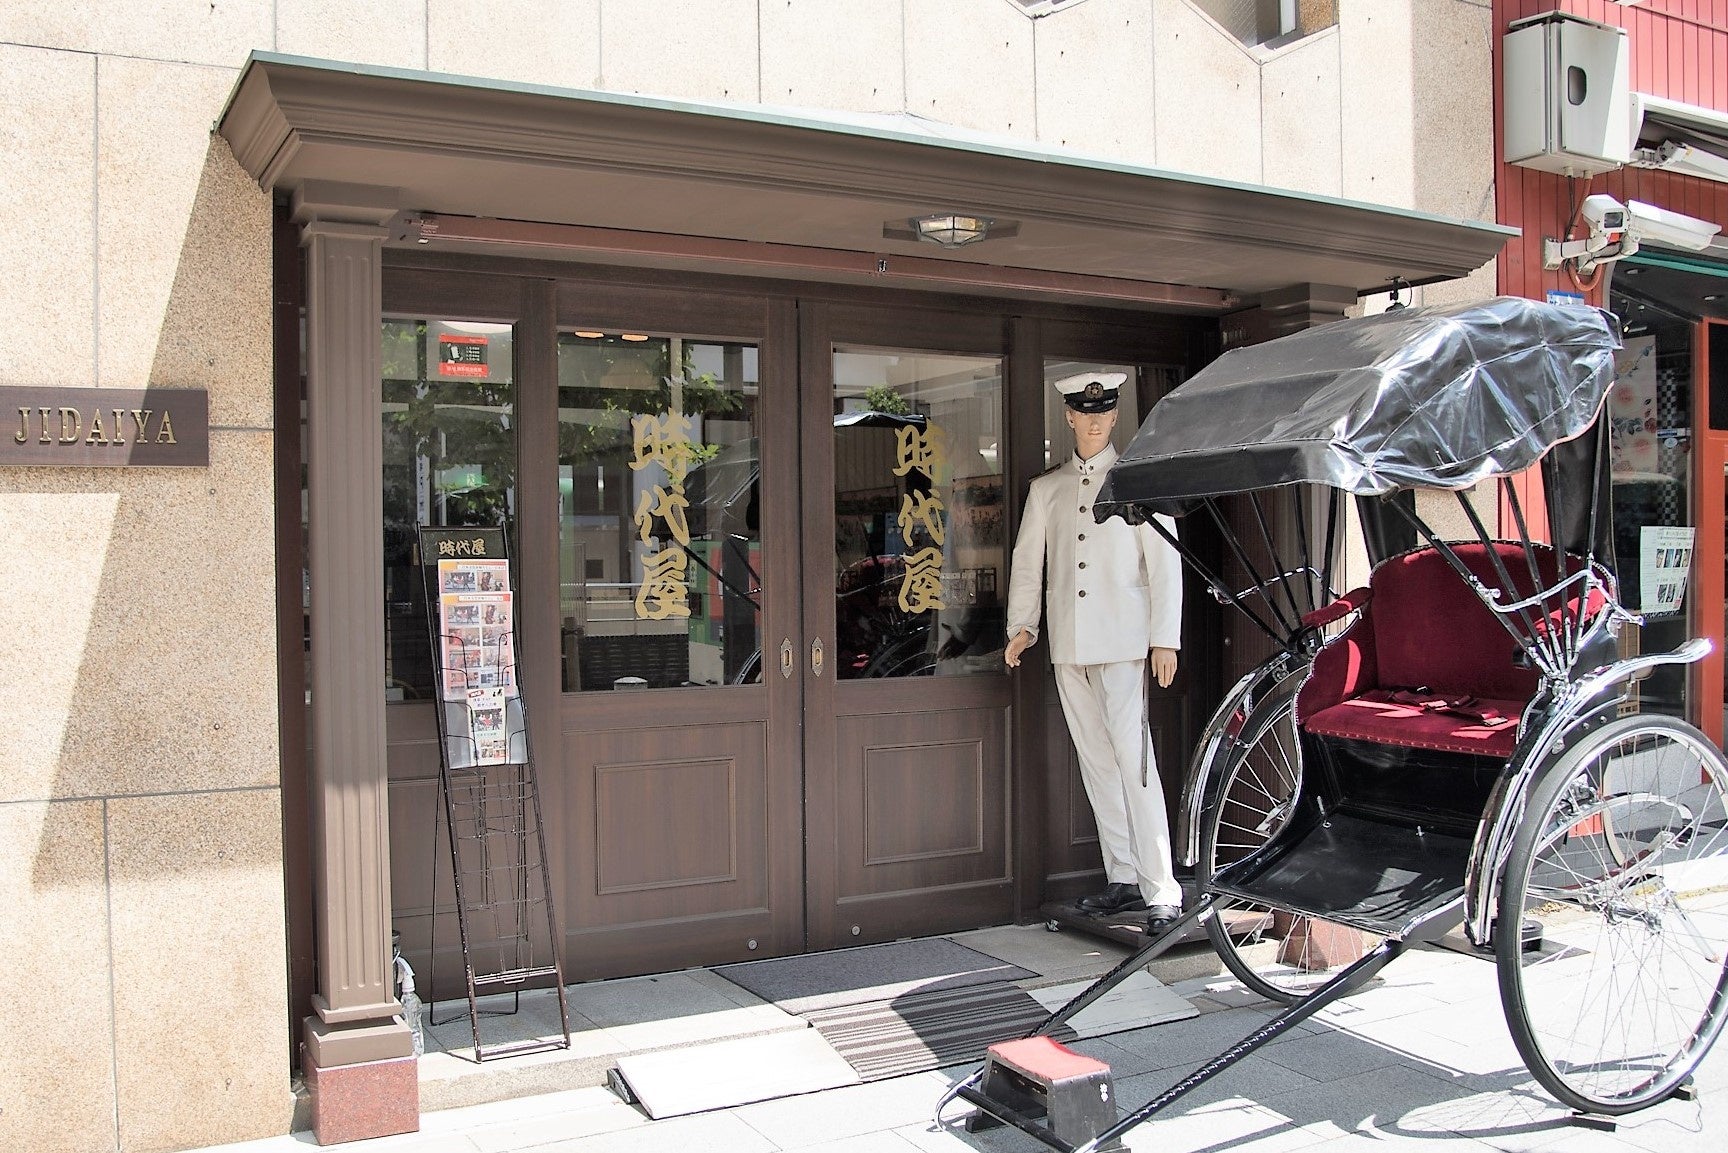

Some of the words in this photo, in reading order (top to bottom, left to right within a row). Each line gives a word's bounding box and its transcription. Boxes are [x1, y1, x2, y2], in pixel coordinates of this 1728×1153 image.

[15, 407, 177, 445] JIDAIYA
[438, 538, 487, 557] 時代屋
[628, 406, 692, 620] 時代屋
[892, 418, 947, 614] 時代屋
